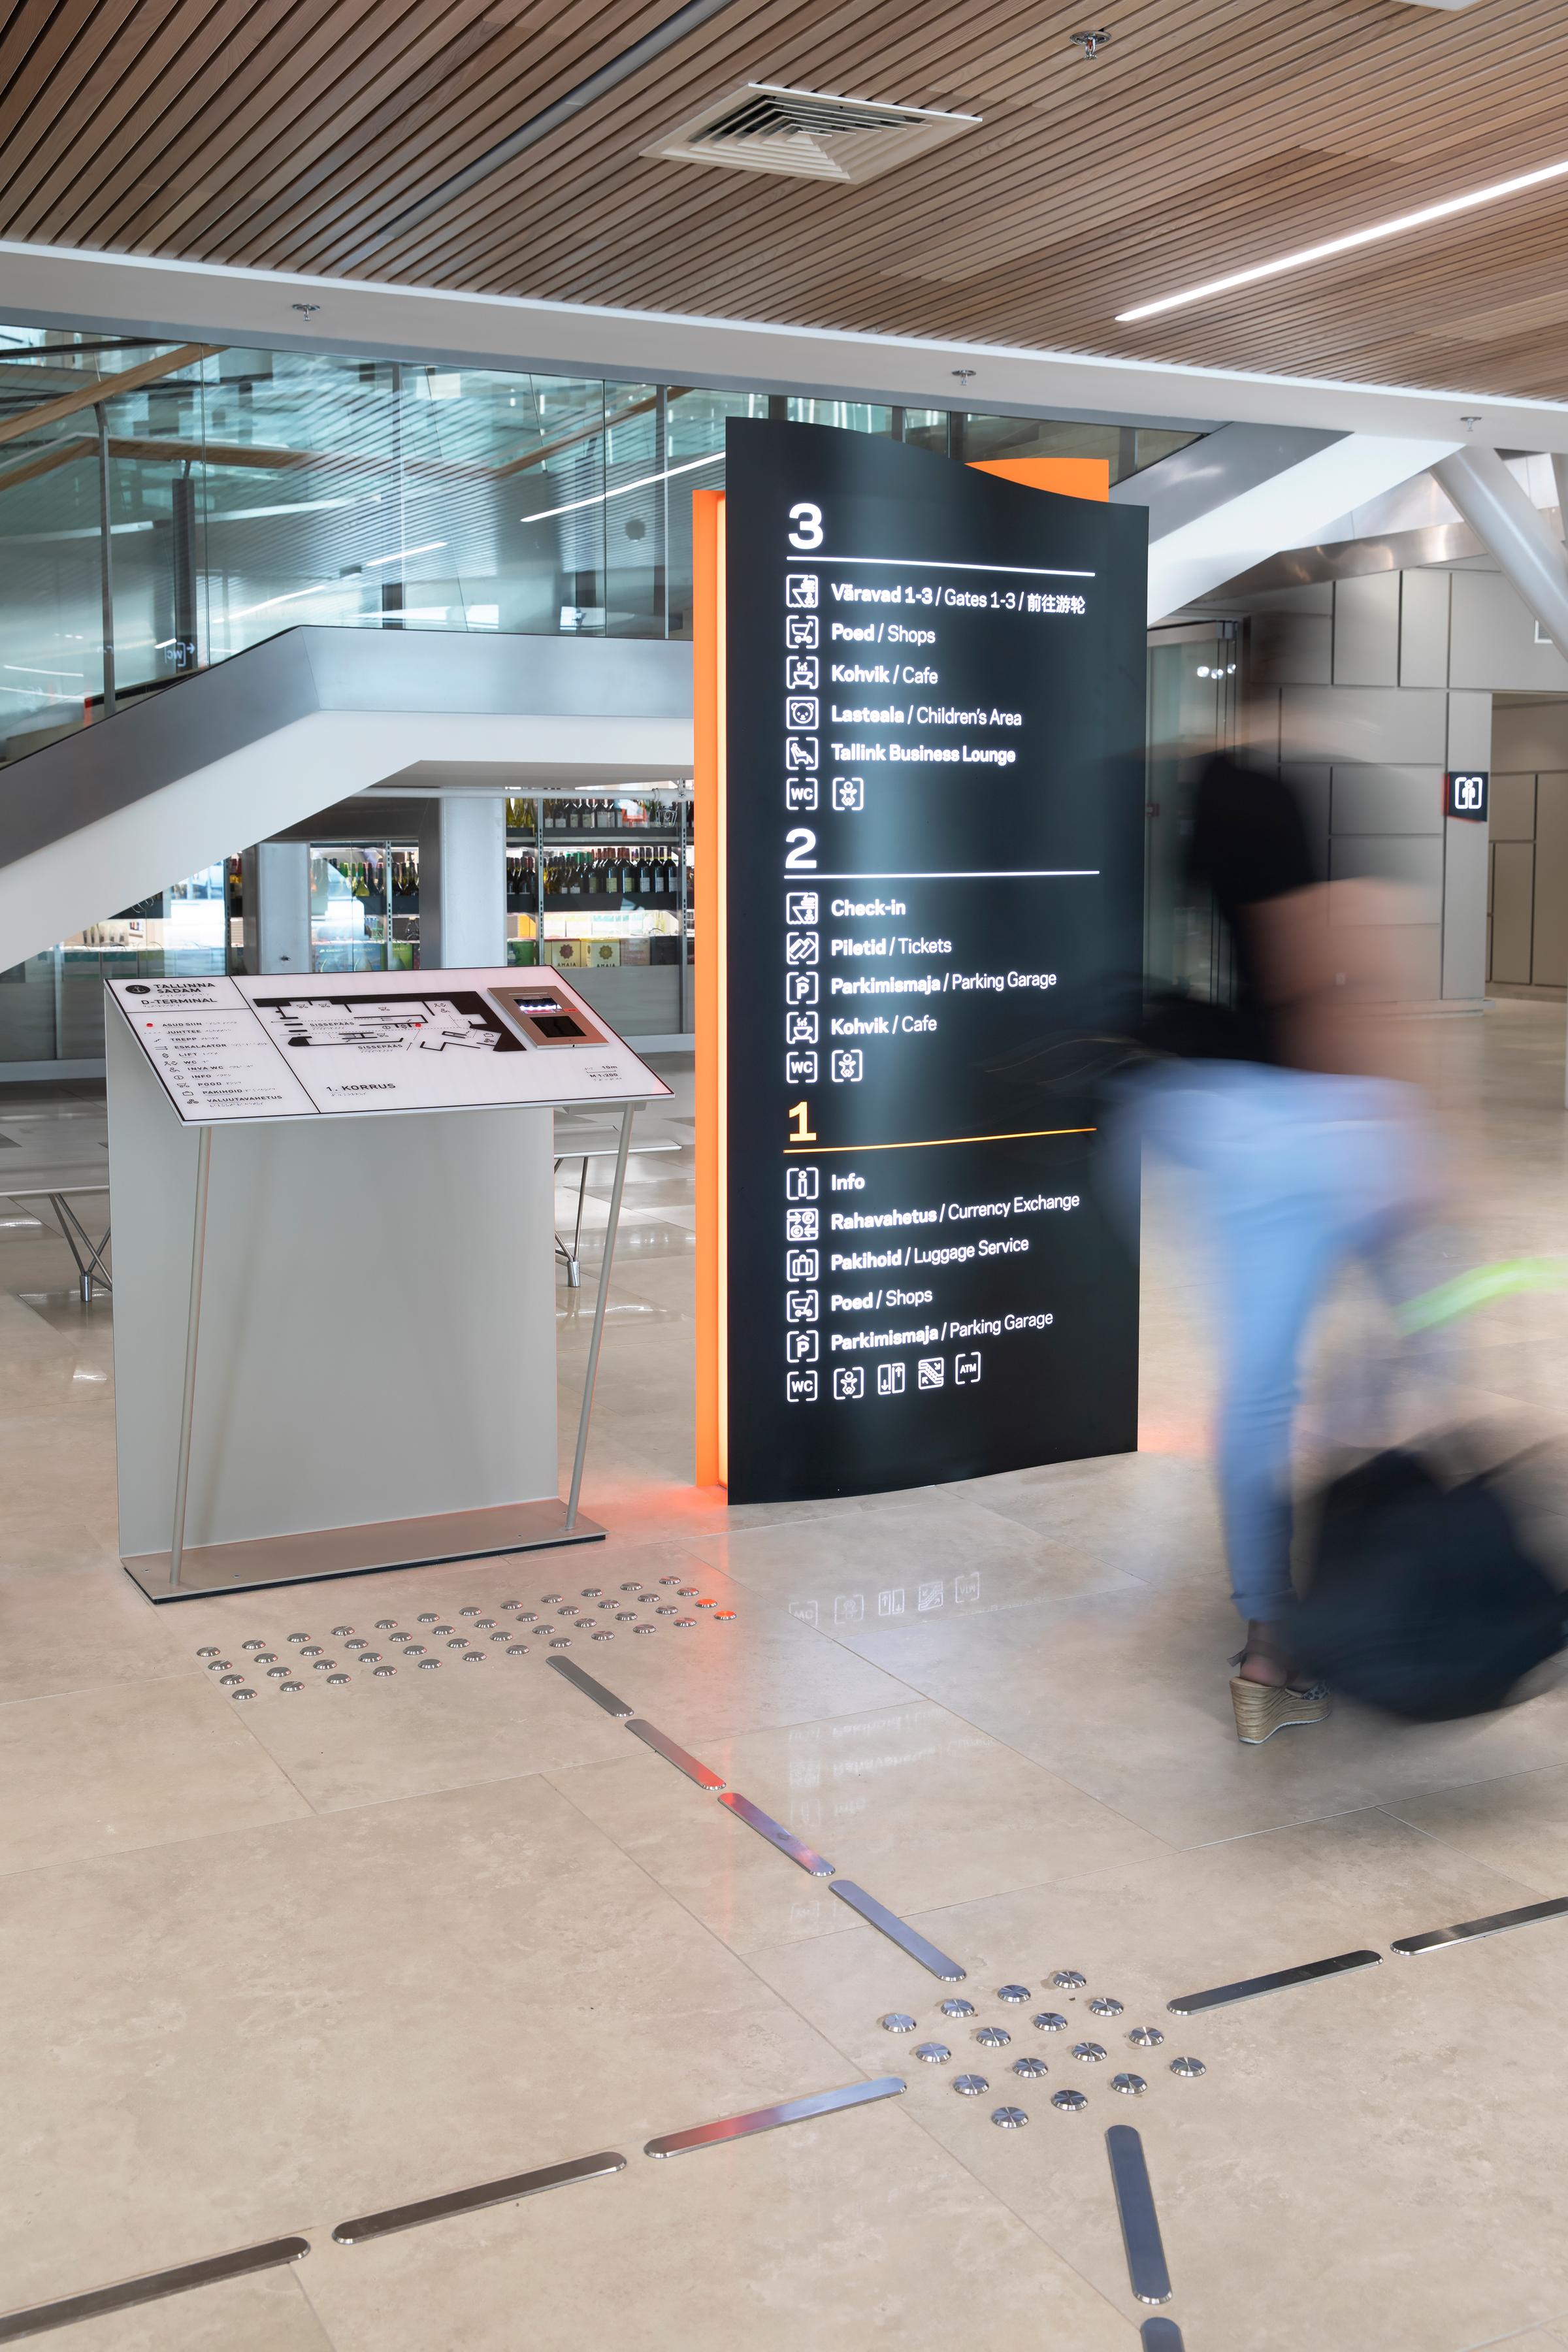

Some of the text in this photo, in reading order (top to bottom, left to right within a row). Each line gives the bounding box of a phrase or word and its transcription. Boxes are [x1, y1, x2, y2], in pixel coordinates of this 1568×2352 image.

[789, 503, 823, 549] 3
[831, 583, 1085, 614] Väravad 1-3 / Gates 1-3 / 前往游轮
[832, 623, 936, 646] Poed / Shops
[832, 664, 938, 684] Kohvik / Cafe
[832, 705, 904, 723] Lasteala
[907, 705, 913, 725] /
[990, 709, 1021, 725] Area
[831, 743, 1015, 766] Tallink Business Lounge
[791, 787, 814, 801] WC
[785, 828, 817, 868] 2
[832, 899, 906, 916] Check-in
[832, 936, 951, 956] Piletid / Tickets
[832, 972, 1056, 995] Parkimismaja / Parking Garage
[832, 1015, 937, 1035] Kohvik / Cafe
[791, 1060, 813, 1074] WC
[789, 1102, 816, 1141] 1
[832, 1173, 865, 1190] Info
[832, 1195, 1079, 1230] Rahavahetus / Currency Exchange
[832, 1237, 1028, 1270] Pakihoid / Luggage Service
[832, 1289, 932, 1311] Poed / Shops
[832, 1314, 1053, 1350] Parkimismaja / Parking Garage
[959, 1362, 977, 1374] ATM
[791, 1380, 814, 1393] WC
